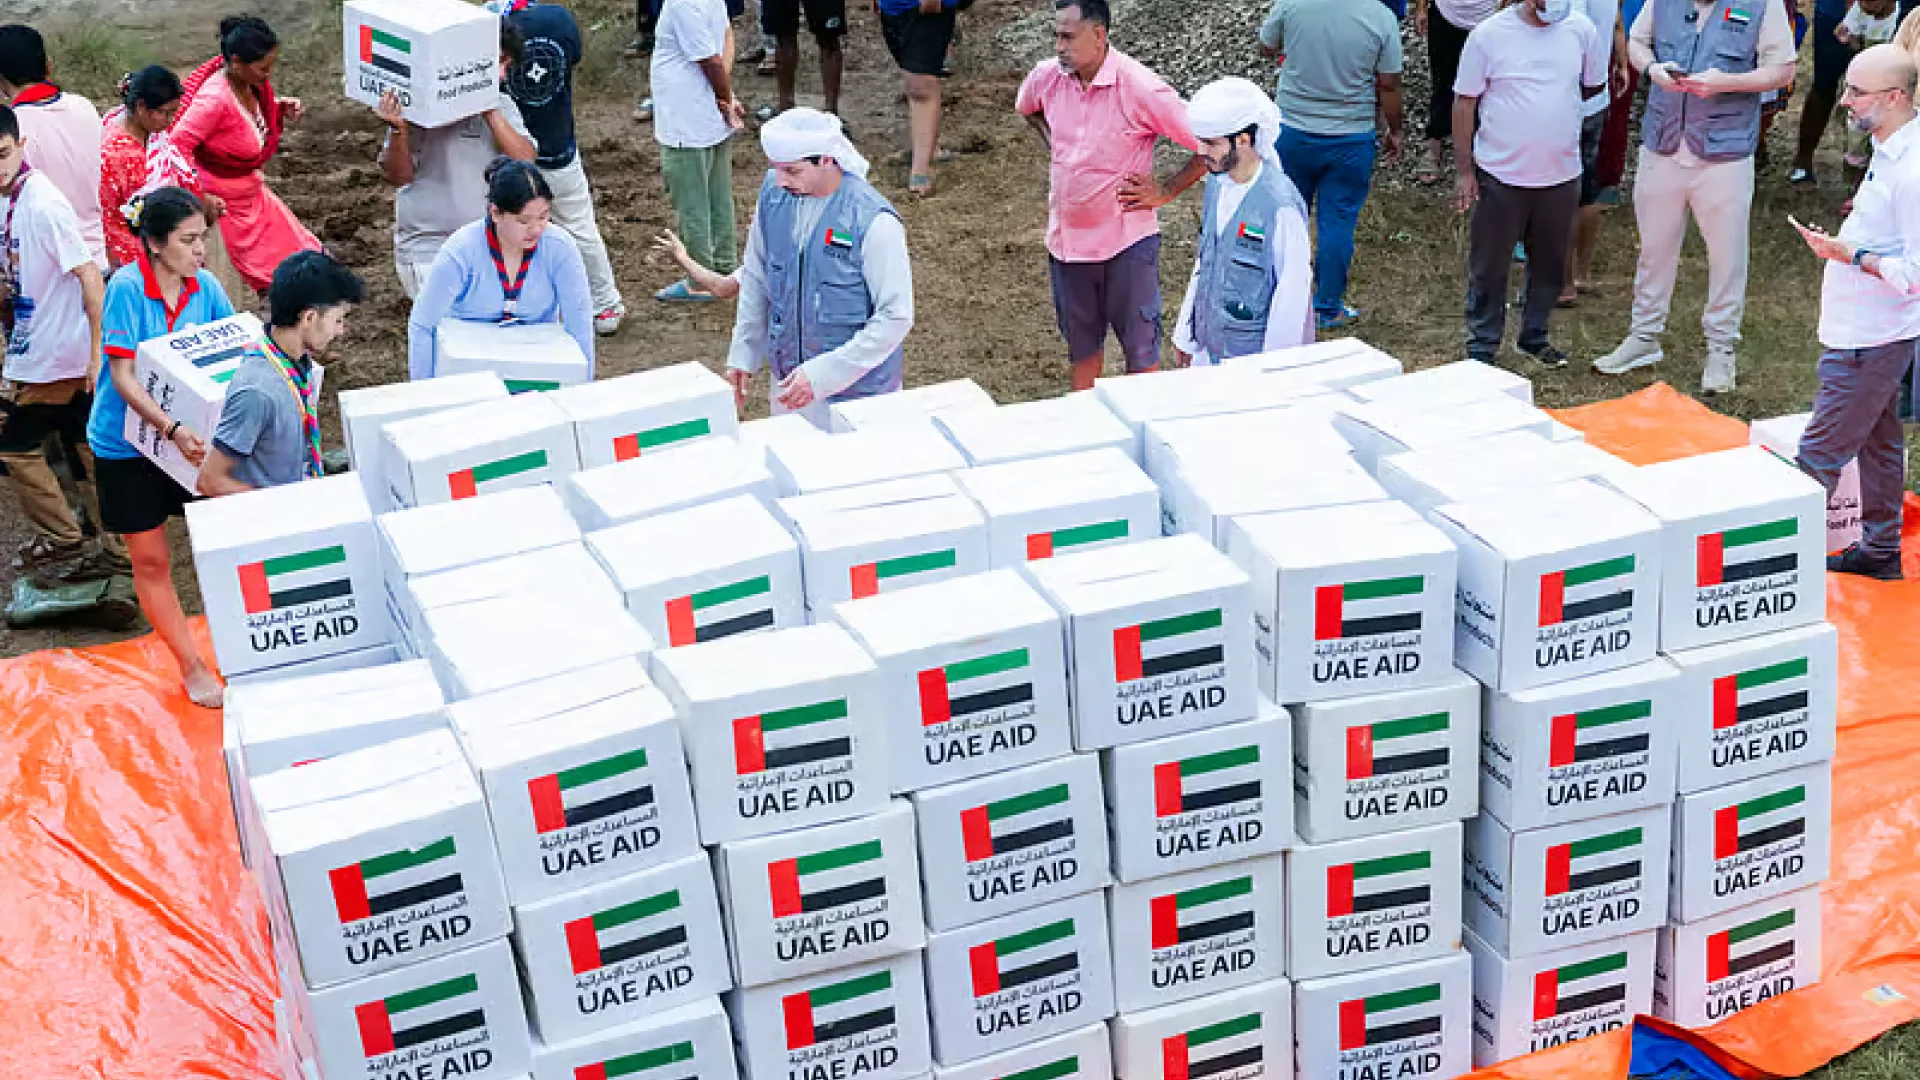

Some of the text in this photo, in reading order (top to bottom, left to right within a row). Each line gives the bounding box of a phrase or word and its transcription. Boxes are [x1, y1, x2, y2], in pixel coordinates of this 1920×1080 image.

[1696, 591, 1796, 628] UAE AID
[251, 624, 308, 652] UAE
[313, 615, 359, 641] AID
[1535, 629, 1631, 667] UAE AID
[1312, 651, 1420, 683] UAE AID
[1117, 685, 1225, 725] UAE AID
[925, 723, 1036, 765] UAE AID
[1712, 728, 1808, 768] UAE AID
[738, 778, 853, 818] UAE AID
[1345, 787, 1448, 821] UAE AID
[1547, 771, 1647, 806] UAE AID
[542, 826, 661, 876] UAE AID
[1156, 819, 1263, 859] UAE AID
[969, 857, 1078, 902] UAE AID
[1715, 855, 1804, 897] UAE AID
[1542, 898, 1640, 936] UAE AID
[345, 915, 471, 965] UAE AID
[776, 919, 889, 962] UAE AID
[1326, 922, 1431, 958] UAE AID
[1151, 948, 1256, 989] UAE AID
[577, 965, 694, 1014] UAE AID
[1706, 975, 1794, 1020] UAE AID
[976, 991, 1081, 1037] UAE AID
[441, 1049, 493, 1080] AID
[851, 1047, 899, 1075] AID
[1396, 1052, 1441, 1078] AID
